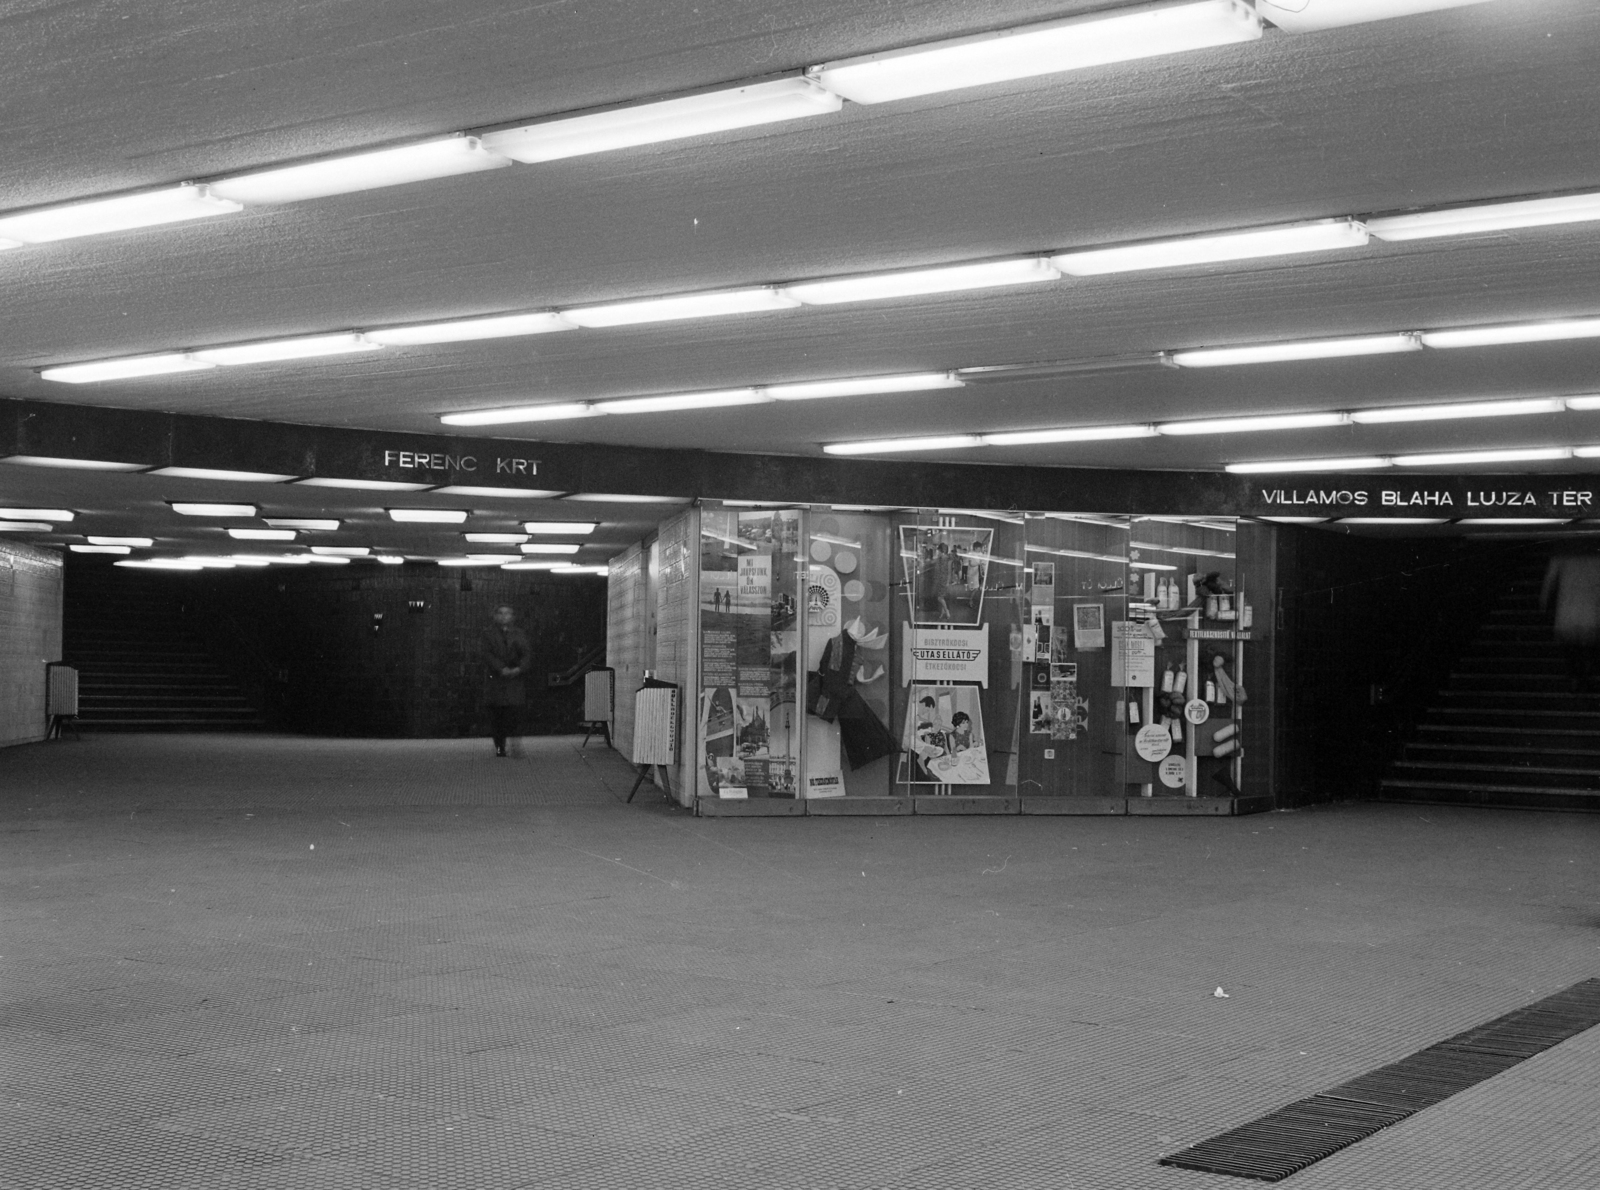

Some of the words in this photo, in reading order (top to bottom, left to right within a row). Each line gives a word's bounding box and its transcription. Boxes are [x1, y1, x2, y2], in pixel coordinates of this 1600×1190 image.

[385, 450, 477, 471] FERENC
[496, 457, 542, 476] KRT
[1262, 489, 1369, 506] VILLAMOS
[1381, 490, 1454, 506] BLAHA
[1467, 491, 1537, 506] LUJZA
